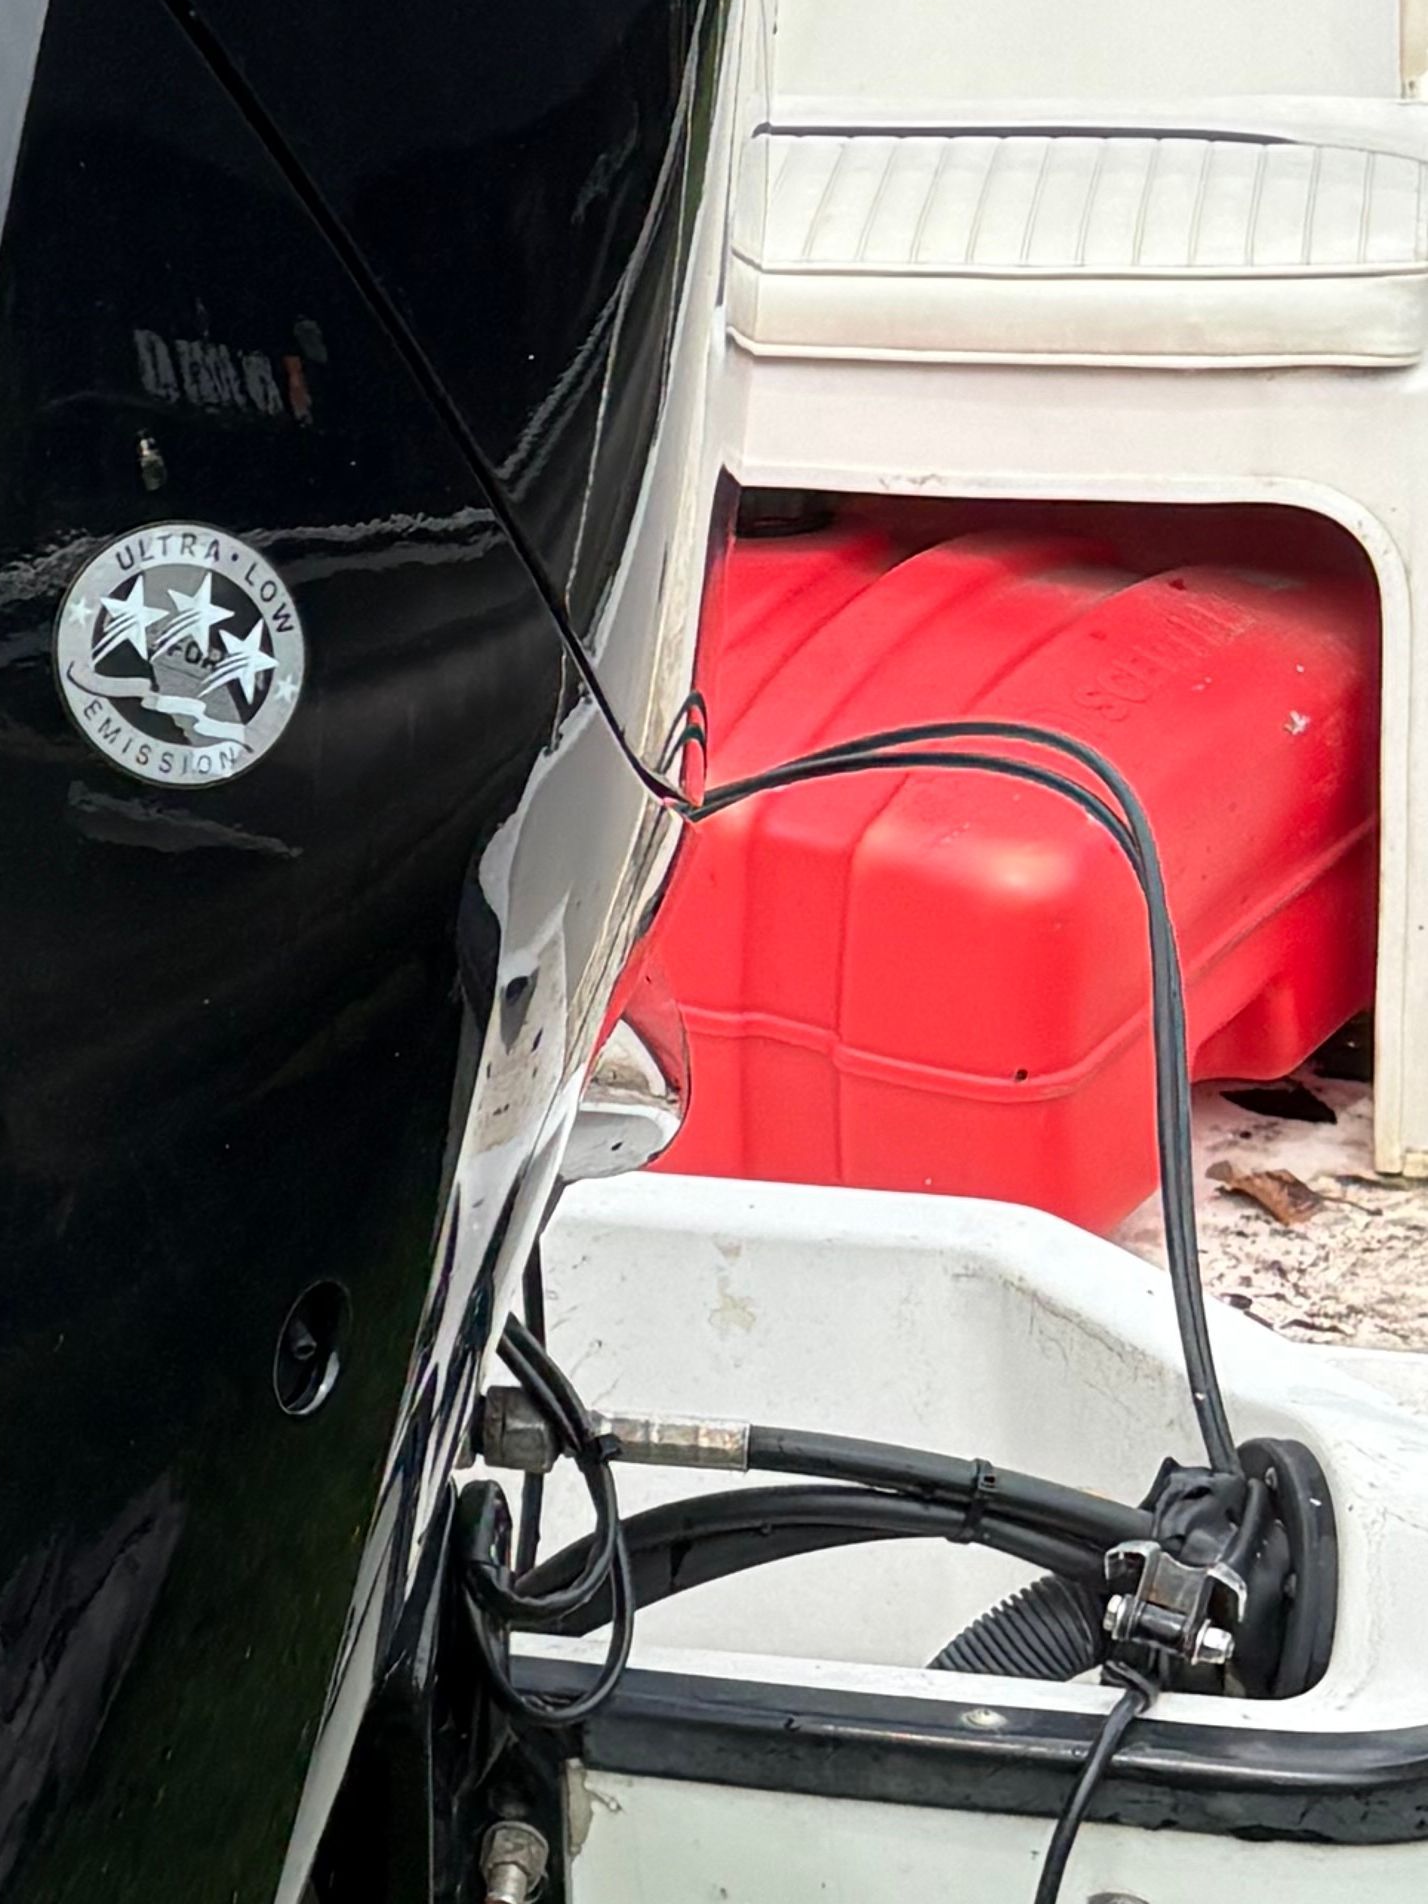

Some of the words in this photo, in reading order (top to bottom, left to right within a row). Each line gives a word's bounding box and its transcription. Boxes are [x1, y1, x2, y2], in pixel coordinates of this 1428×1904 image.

[115, 533, 220, 571] ULTRA
[243, 562, 295, 634] LOW
[82, 699, 240, 776] EMISSION
